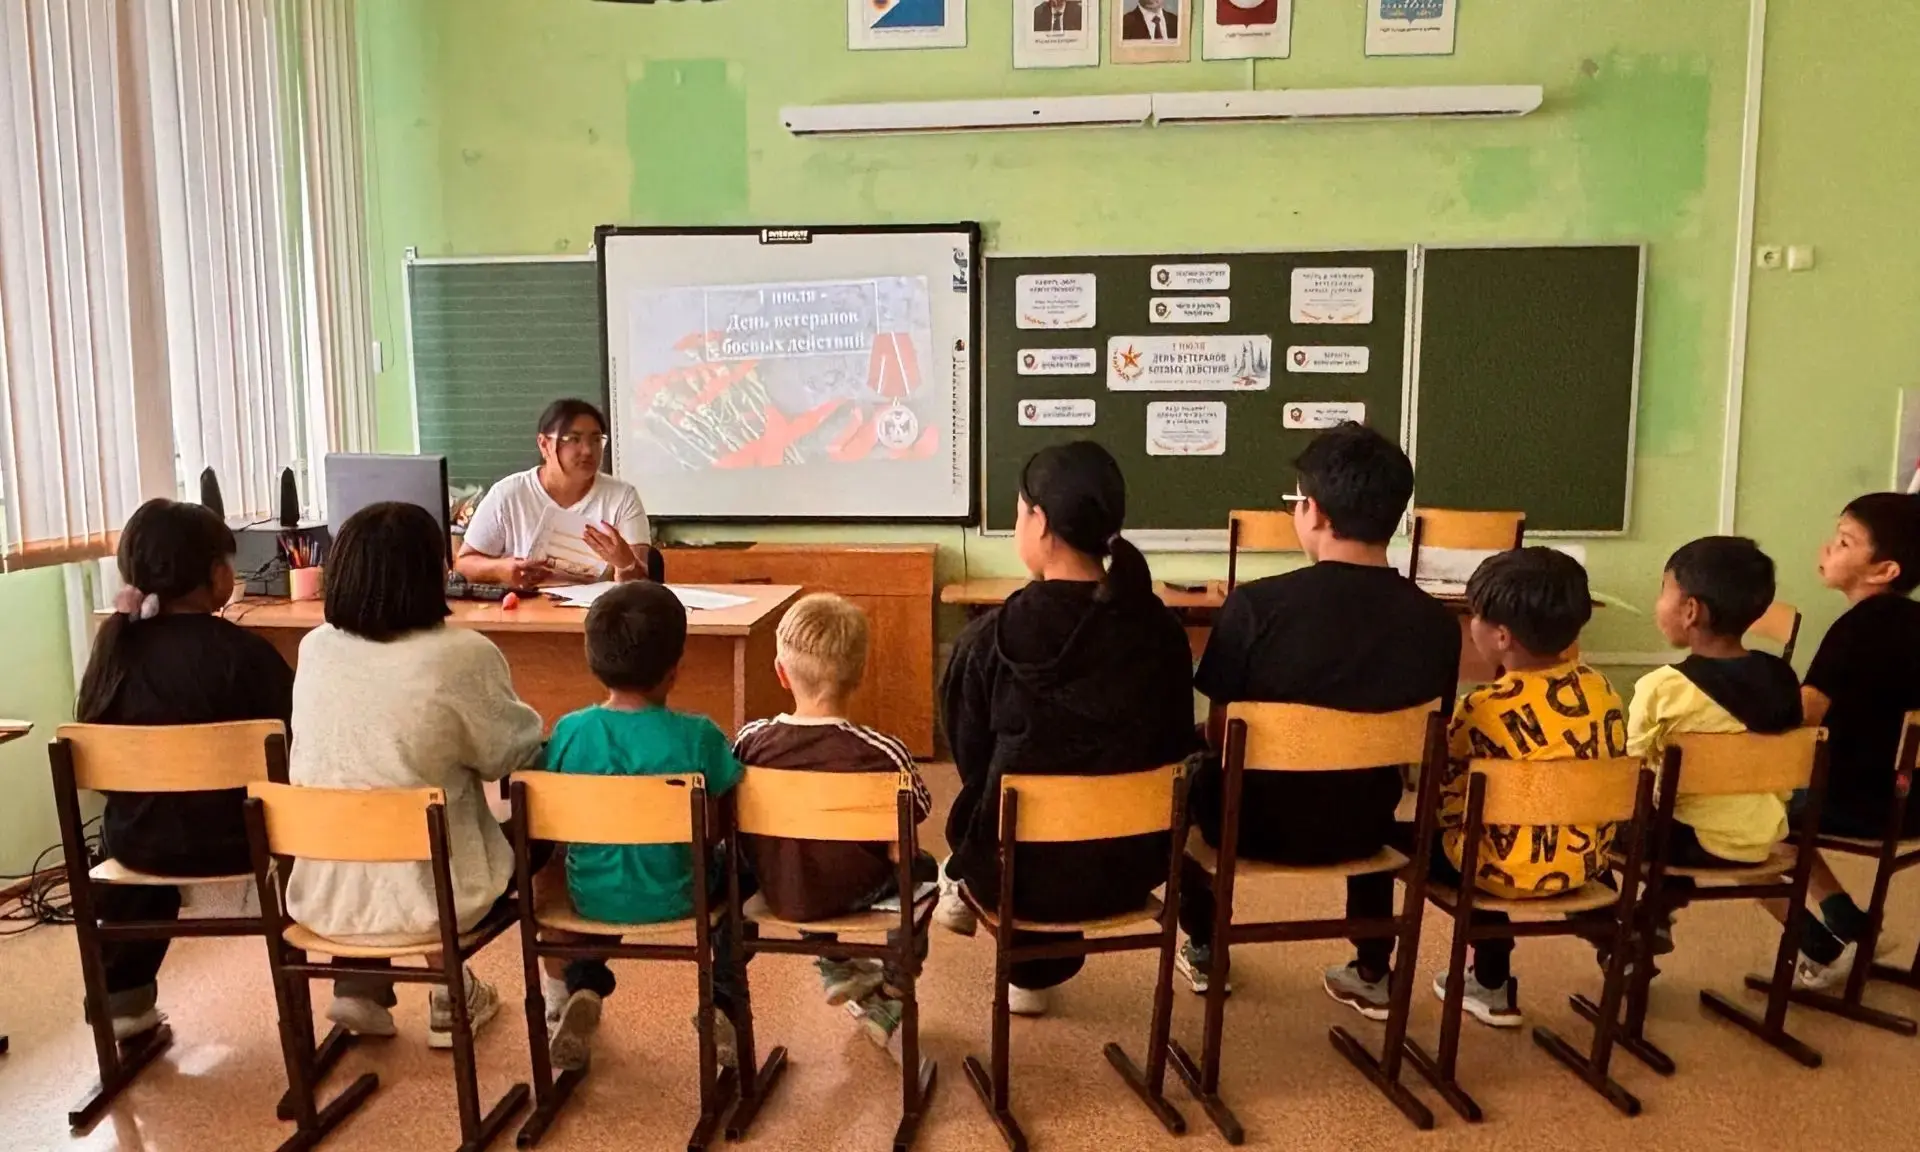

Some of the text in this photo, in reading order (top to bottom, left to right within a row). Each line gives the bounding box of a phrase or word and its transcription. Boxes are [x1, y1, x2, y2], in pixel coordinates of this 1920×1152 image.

[726, 310, 859, 333] День ветеранов
[722, 331, 866, 355] боевых действий
[1177, 352, 1227, 364] ВЕТЕРАНОВ
